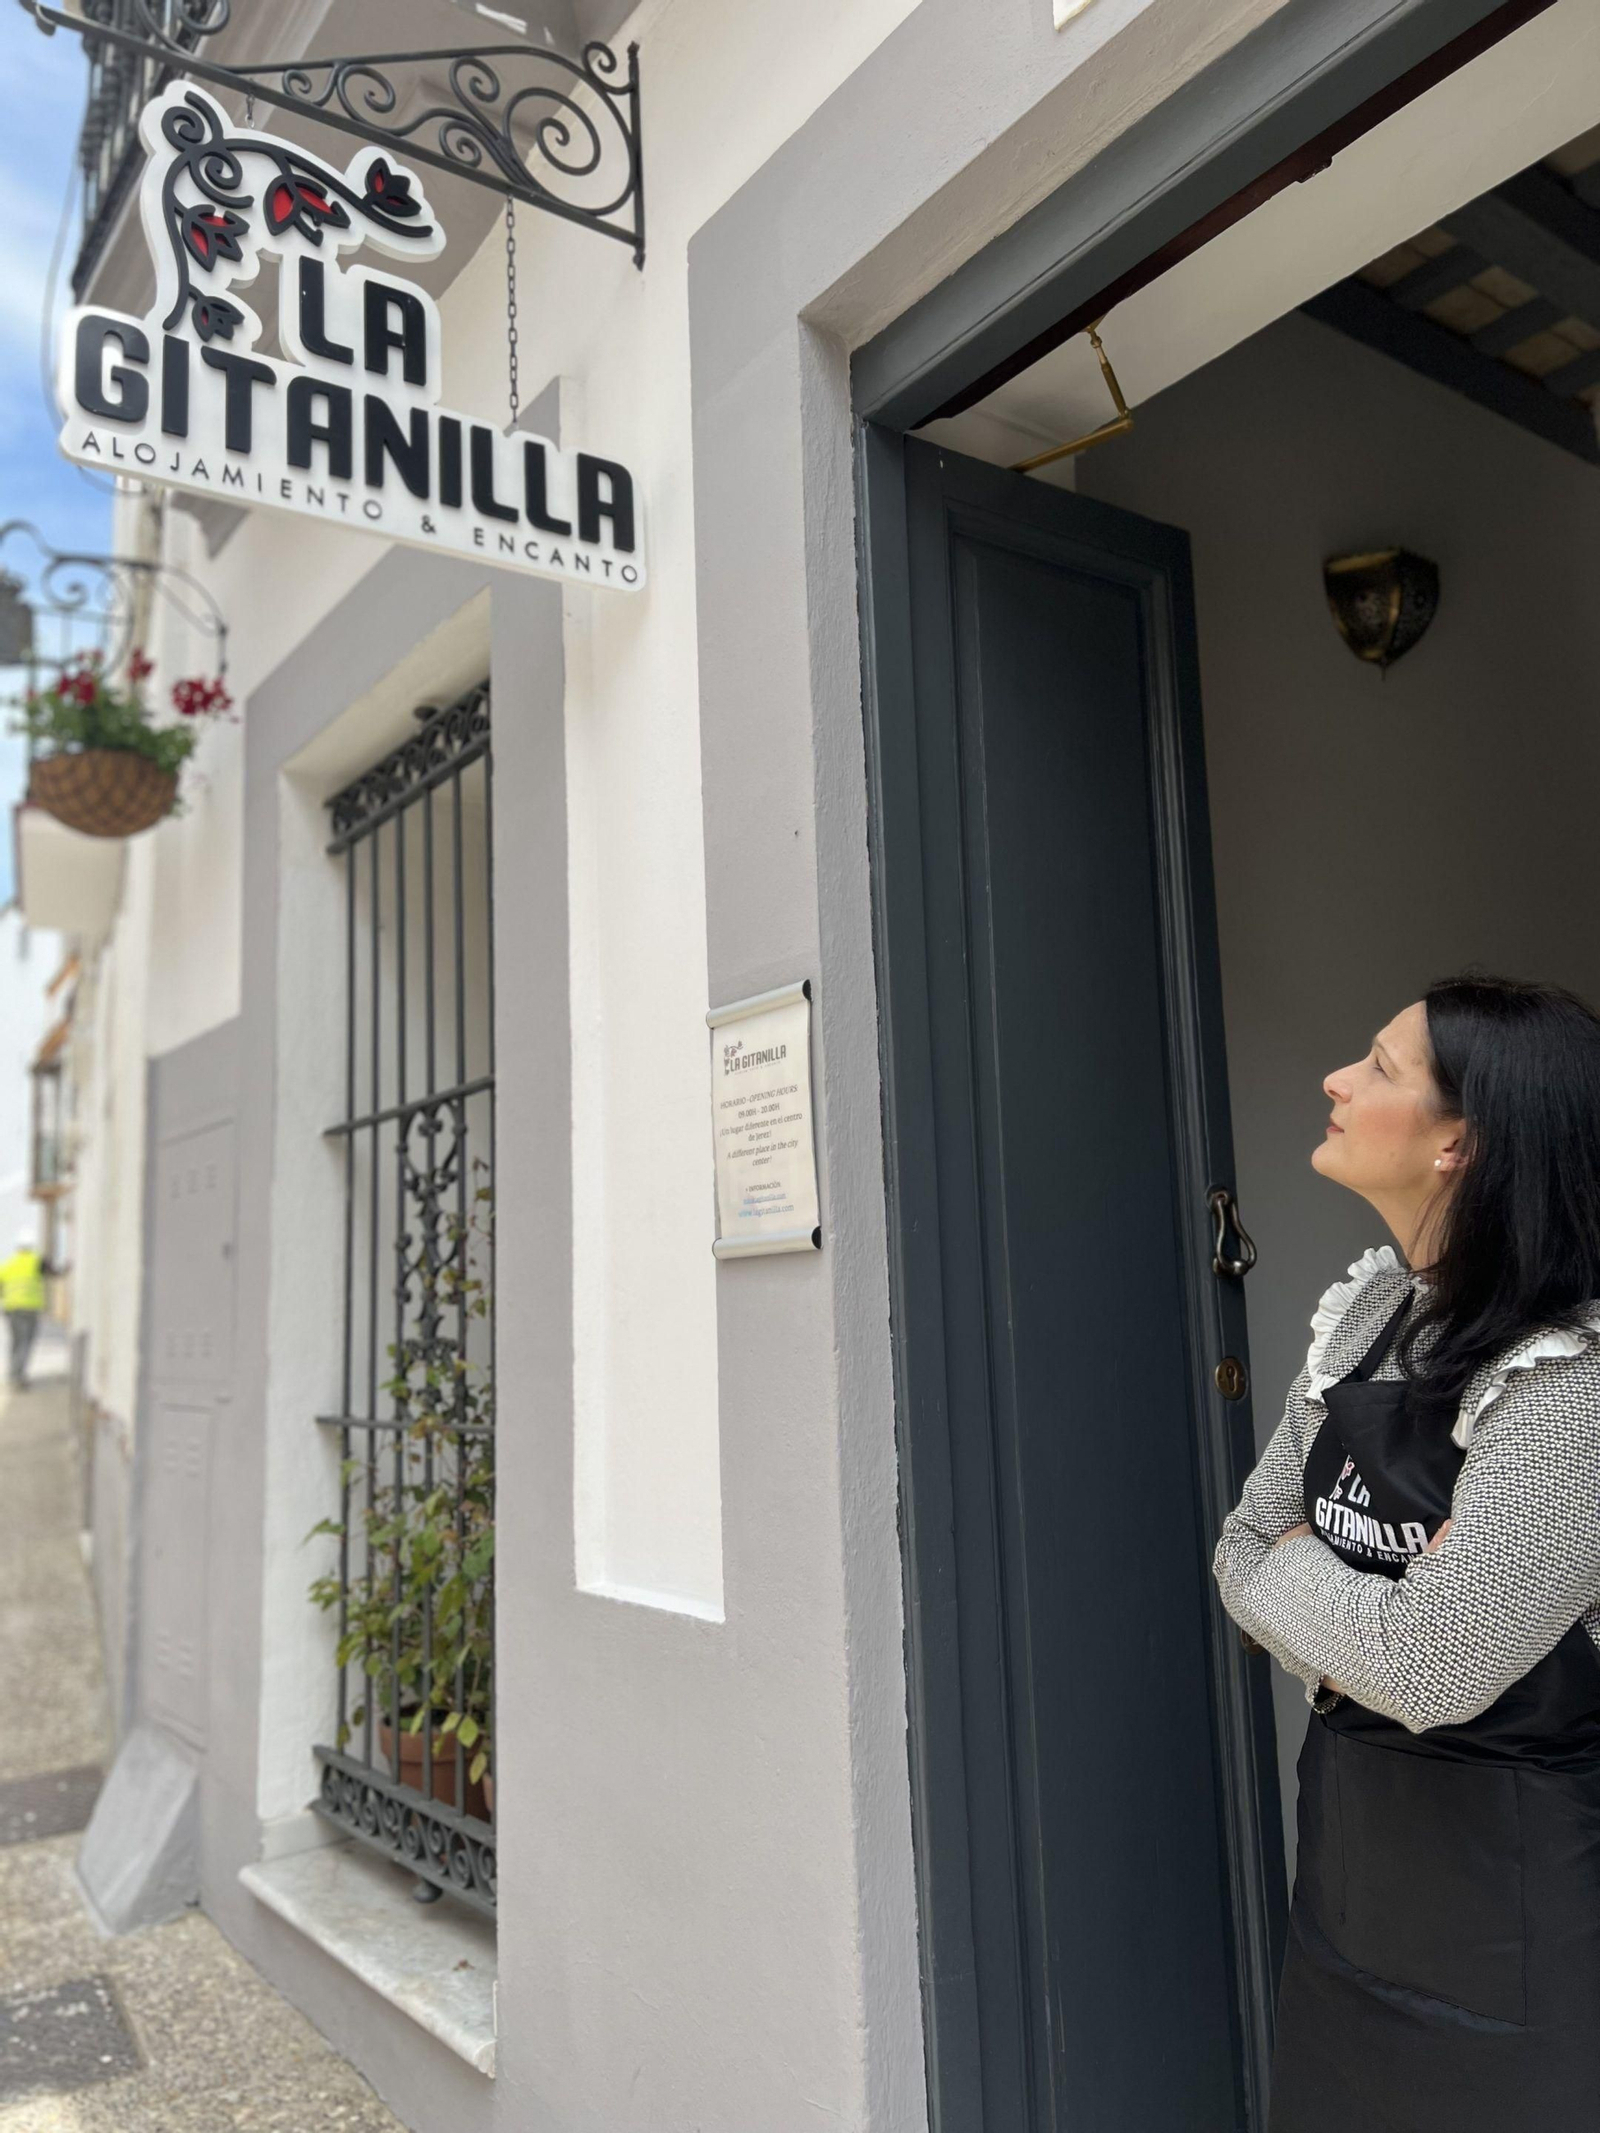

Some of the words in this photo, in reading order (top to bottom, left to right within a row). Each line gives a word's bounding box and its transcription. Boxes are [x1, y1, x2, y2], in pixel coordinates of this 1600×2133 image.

[298, 255, 428, 388] LA
[75, 314, 636, 554] GITANILLA
[81, 431, 384, 522] ALOJAMIENTO
[421, 515, 438, 535] &
[473, 528, 639, 584] ENCANTO
[730, 1057, 740, 1072] LA
[742, 1044, 787, 1069] GITANILLA
[750, 1090, 775, 1103] OPENING
[1315, 1496, 1430, 1554] GITANILLA
